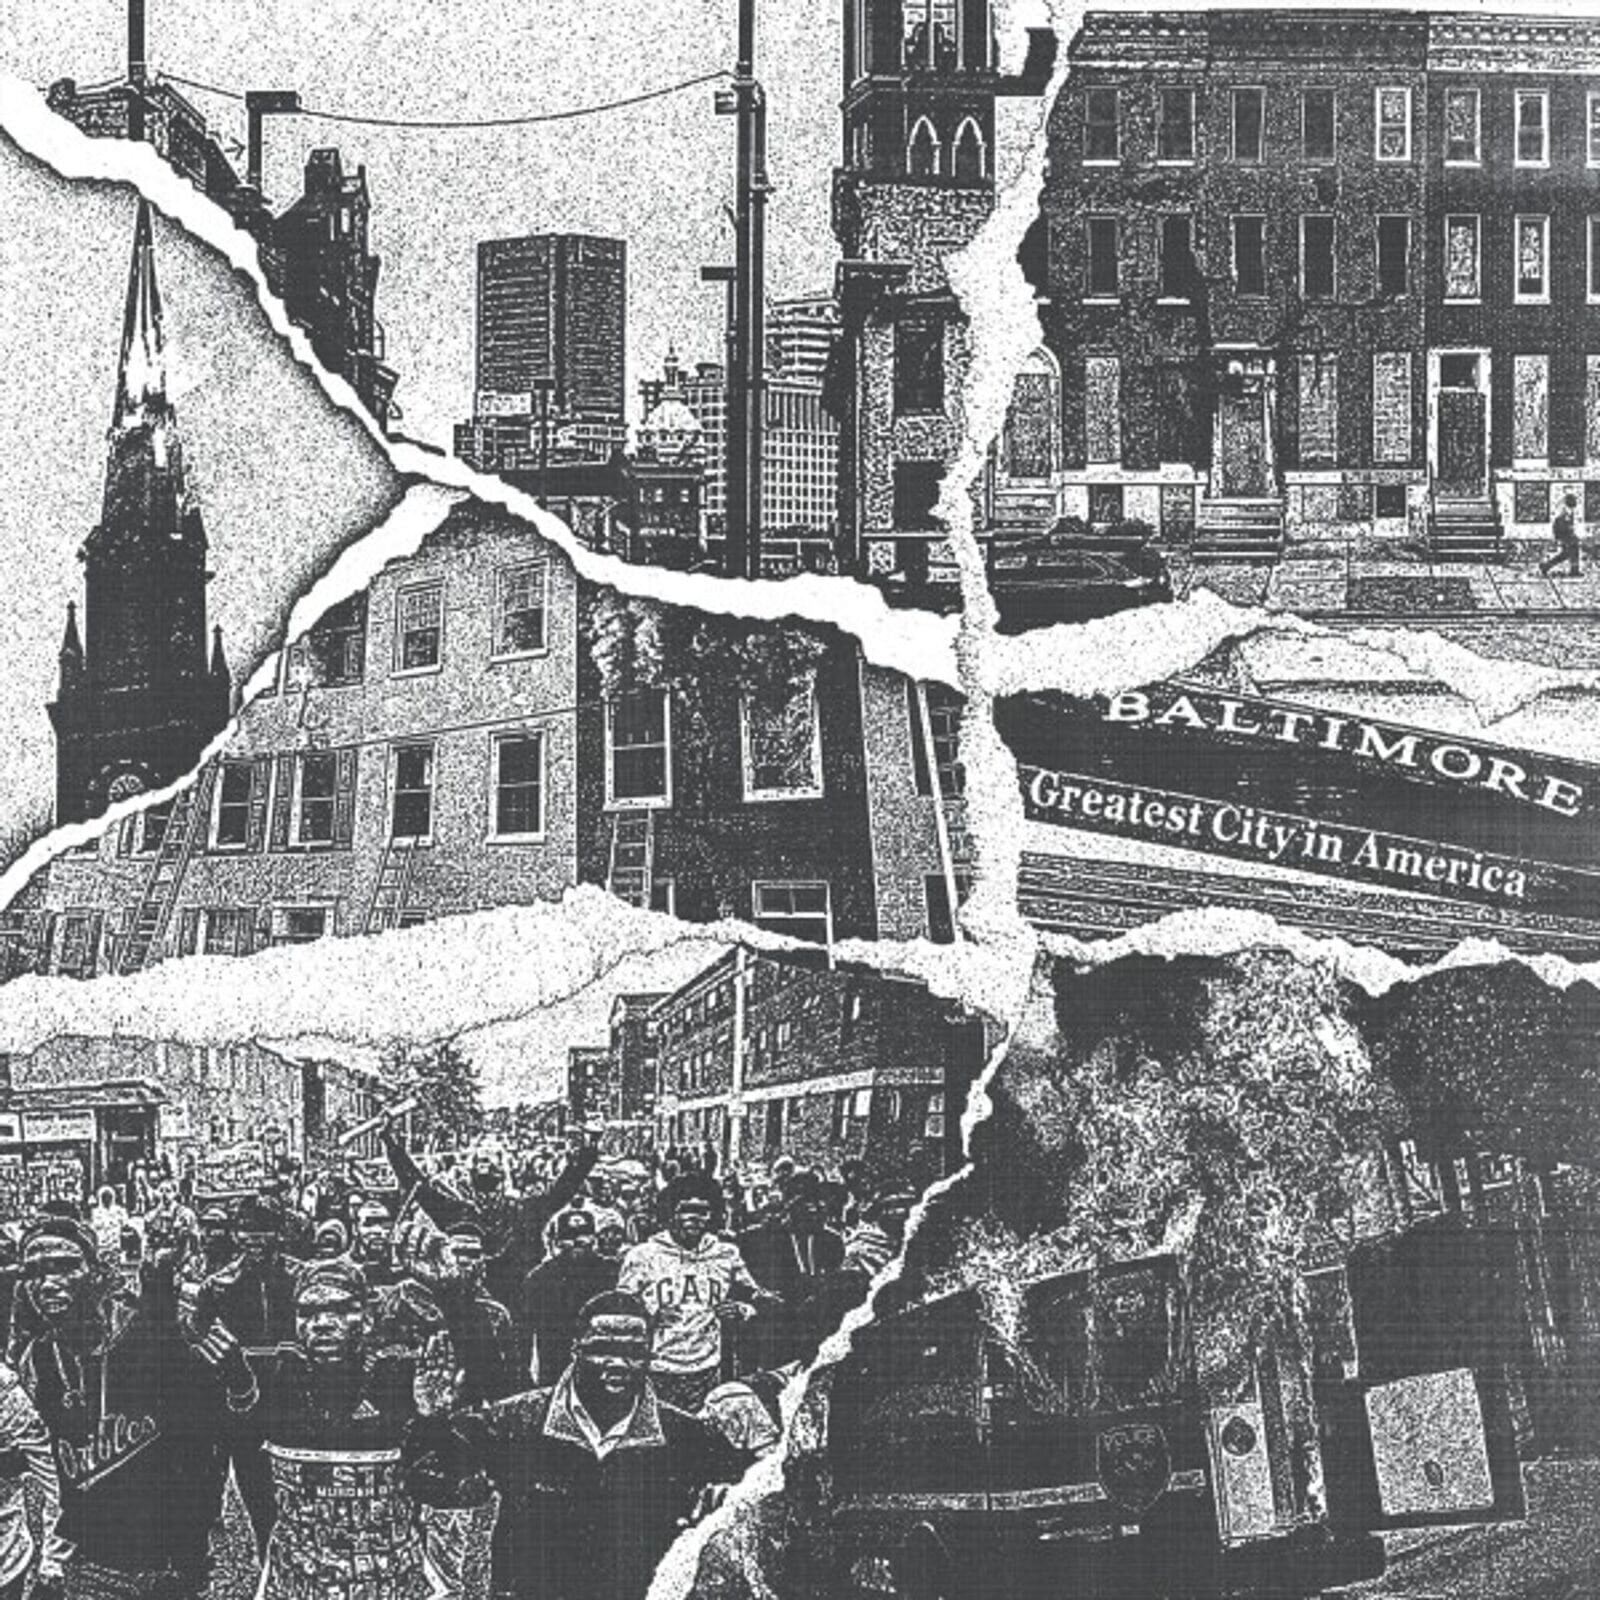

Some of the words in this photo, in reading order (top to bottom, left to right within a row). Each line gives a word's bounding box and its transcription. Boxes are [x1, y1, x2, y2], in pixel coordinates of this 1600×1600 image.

[1102, 691, 1583, 817] BALTIMORE
[1030, 769, 1203, 835] Greatest
[1212, 803, 1297, 860] City
[1302, 818, 1343, 862] in
[1352, 831, 1525, 898] America
